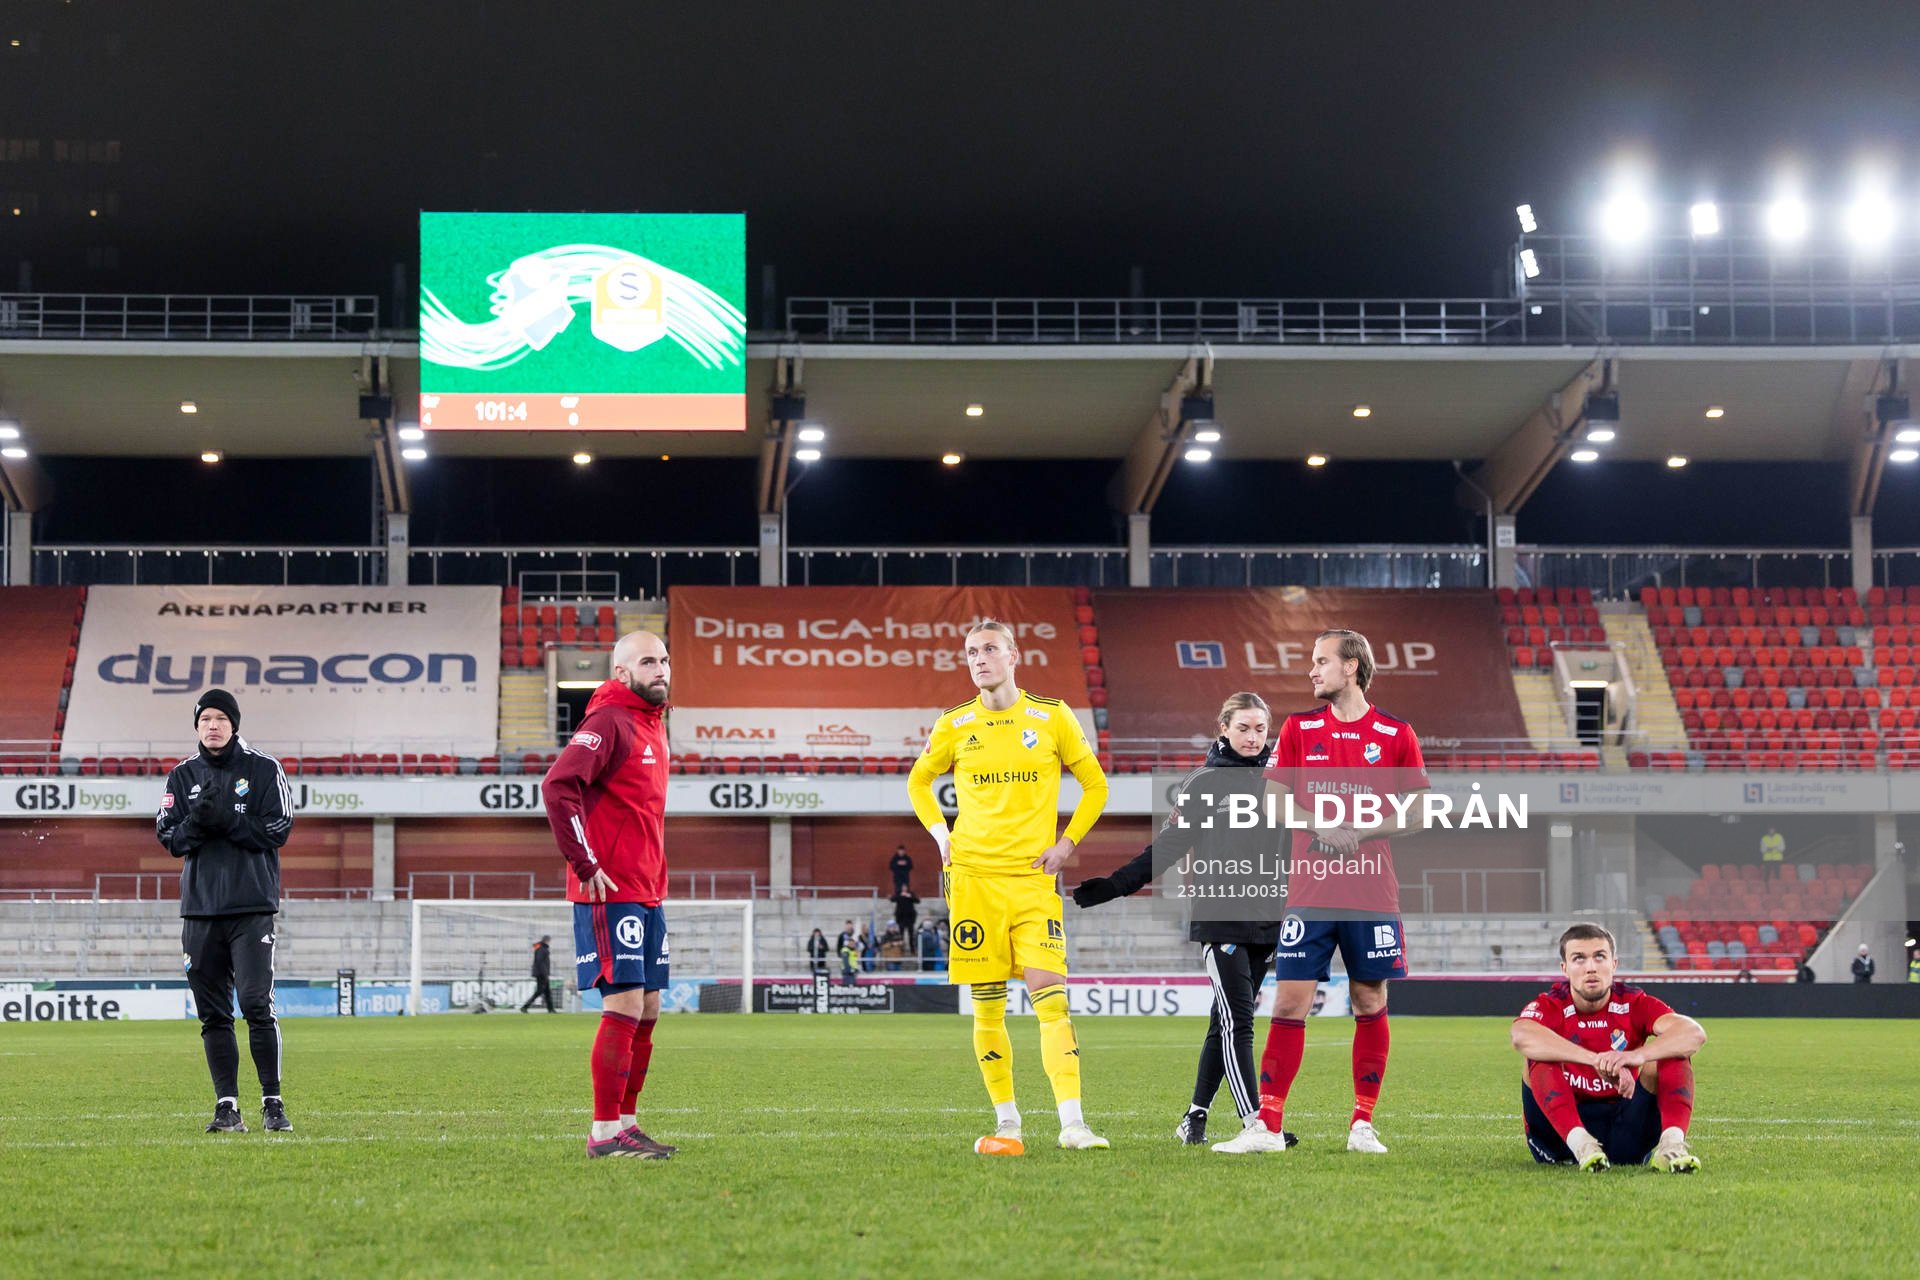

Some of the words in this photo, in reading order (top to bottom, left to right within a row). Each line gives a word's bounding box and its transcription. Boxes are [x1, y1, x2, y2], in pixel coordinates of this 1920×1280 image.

[158, 602, 427, 616] ARENAPARTNER
[695, 616, 784, 639] Dina
[1244, 642, 1303, 669] LF
[1376, 641, 1436, 669] UP
[98, 644, 477, 694] dynacon
[233, 686, 477, 695] ONSTRUCTION
[696, 726, 775, 738] MAXI
[818, 725, 856, 733] ICA
[973, 771, 1038, 785] EMILSHUS
[15, 784, 76, 810] GBJ
[480, 784, 539, 809] GBJ
[710, 783, 768, 809] GBJ
[3, 994, 130, 1022] eloitte.
